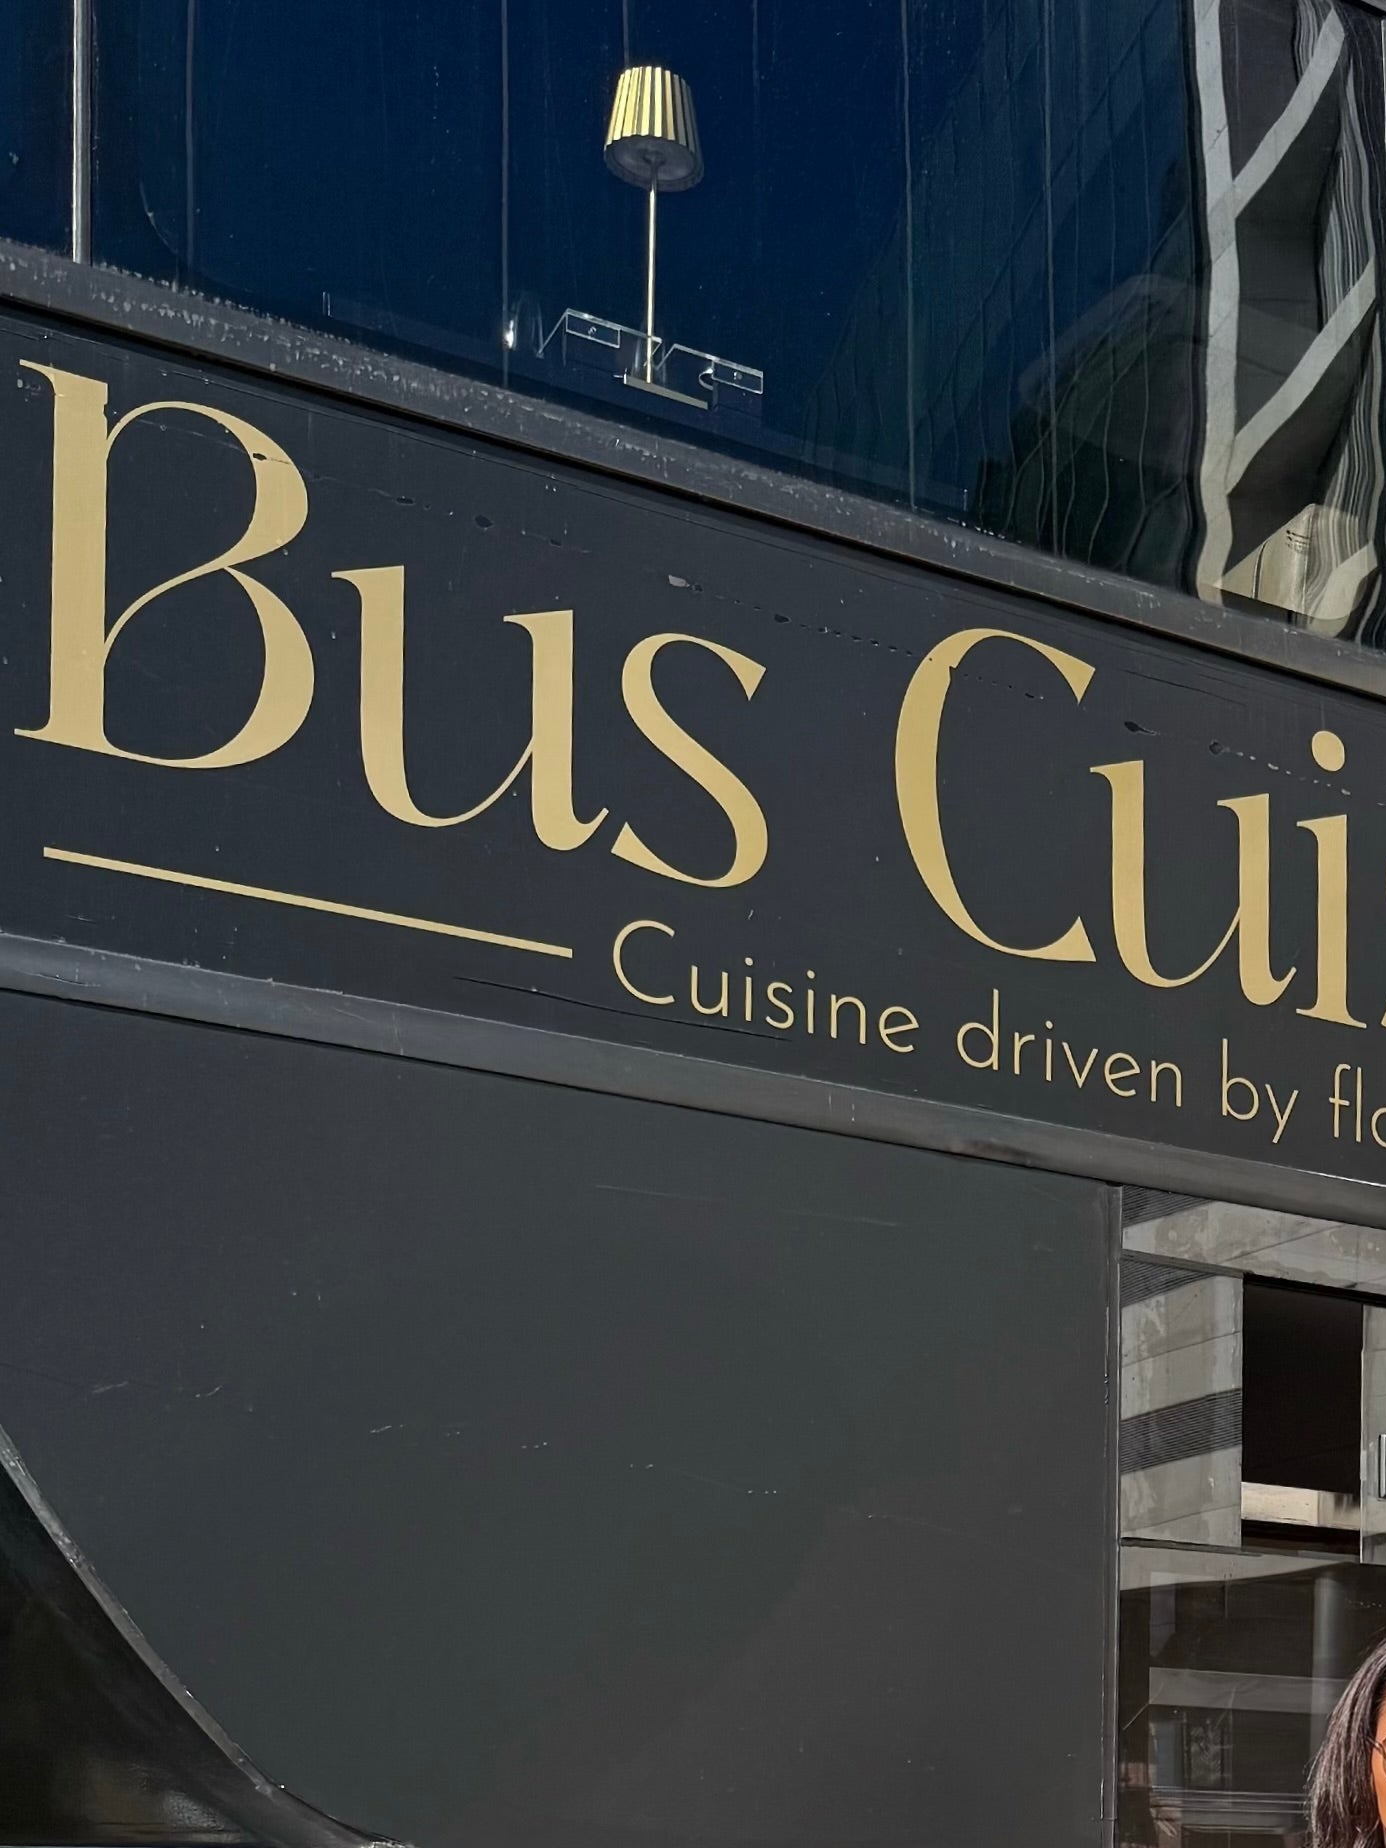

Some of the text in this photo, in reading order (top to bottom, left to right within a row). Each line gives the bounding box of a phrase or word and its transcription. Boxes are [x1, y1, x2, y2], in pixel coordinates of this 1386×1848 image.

[15, 359, 769, 888] Bus
[612, 918, 919, 1055] Cuisine
[956, 987, 1184, 1108] driven
[1220, 1037, 1299, 1145] by
